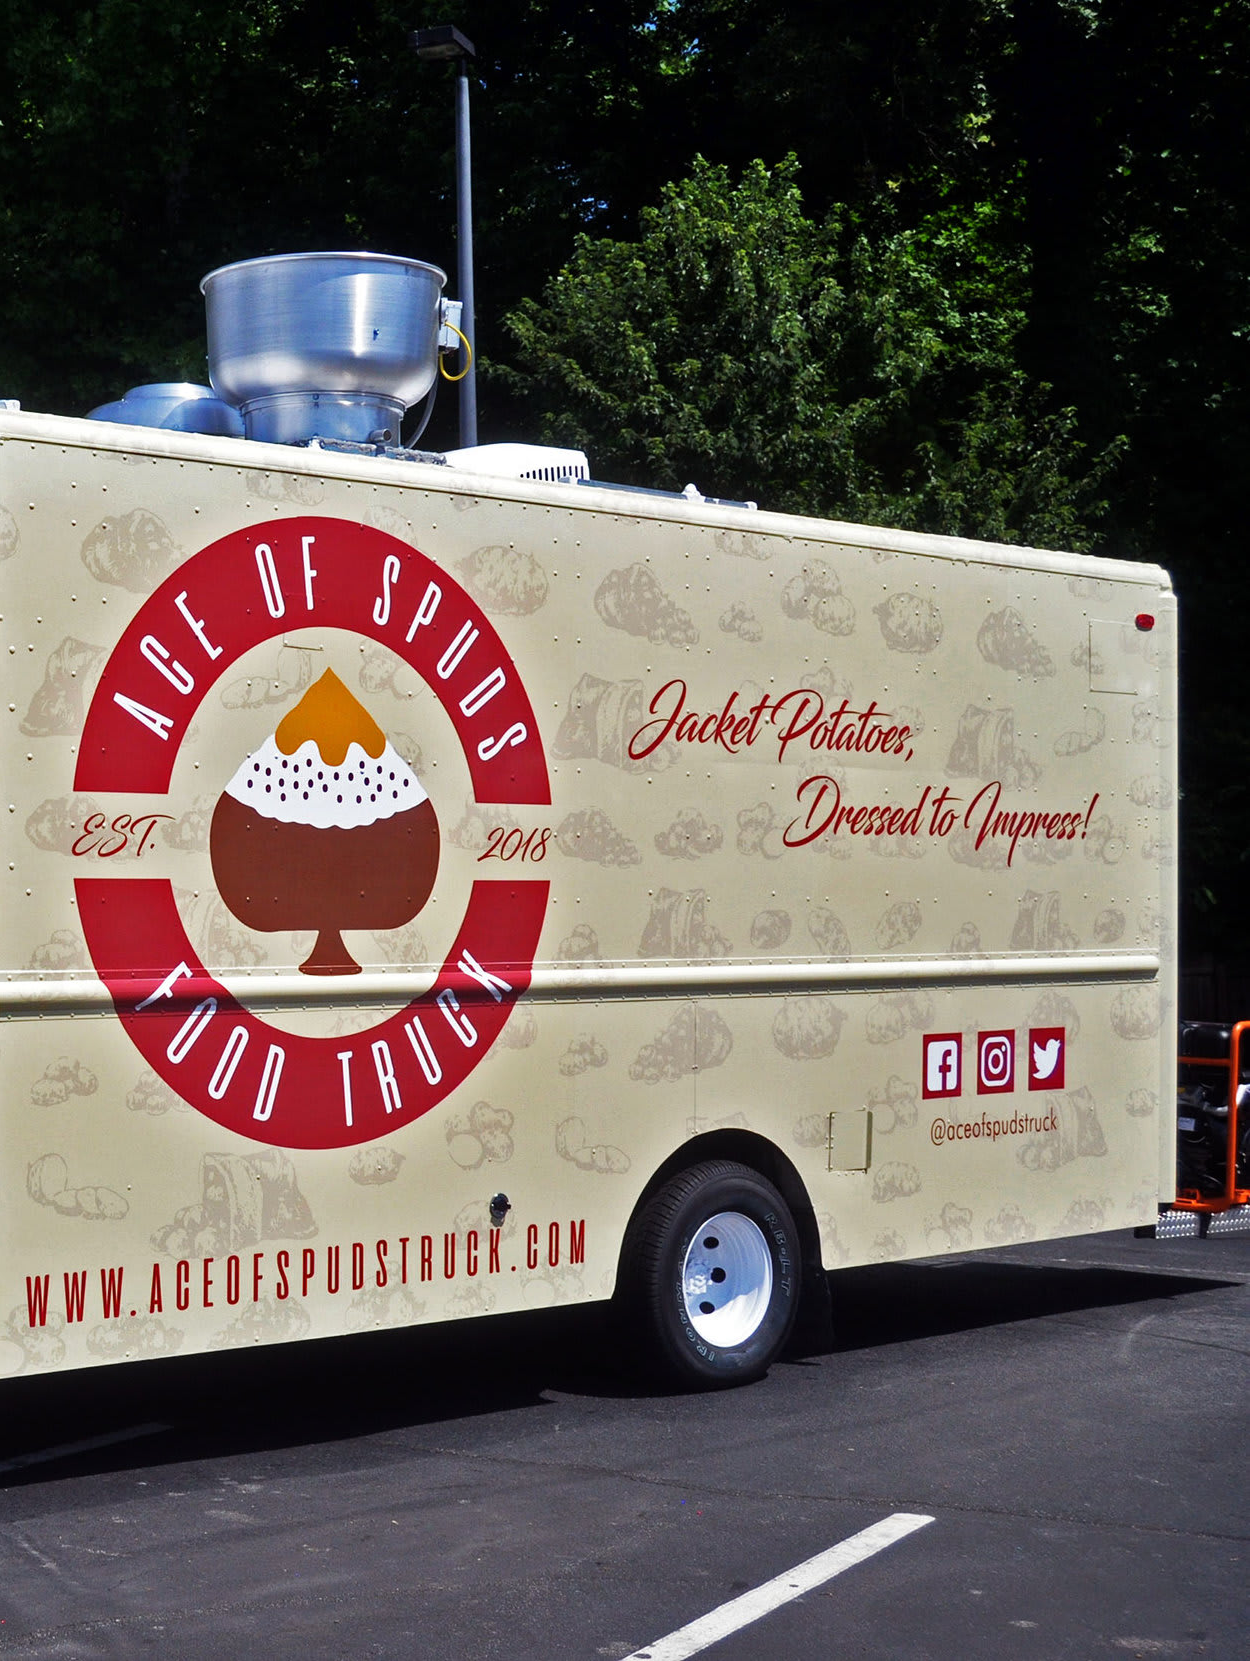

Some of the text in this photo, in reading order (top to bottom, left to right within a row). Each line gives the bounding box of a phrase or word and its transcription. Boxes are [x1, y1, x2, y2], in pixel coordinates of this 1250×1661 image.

[112, 535, 528, 763] ACE OF SPUDS
[628, 678, 915, 763] Jacket Potatoes,
[71, 812, 177, 858] EST.
[477, 826, 552, 863] 2018
[782, 775, 1101, 867] Dressed to Impress!
[134, 948, 514, 1127] FOOD TRUCK
[930, 1107, 1058, 1146] @aceofspudstruck
[26, 1218, 586, 1328] WWW.ACEOFSPUDSTRUCK.COM
